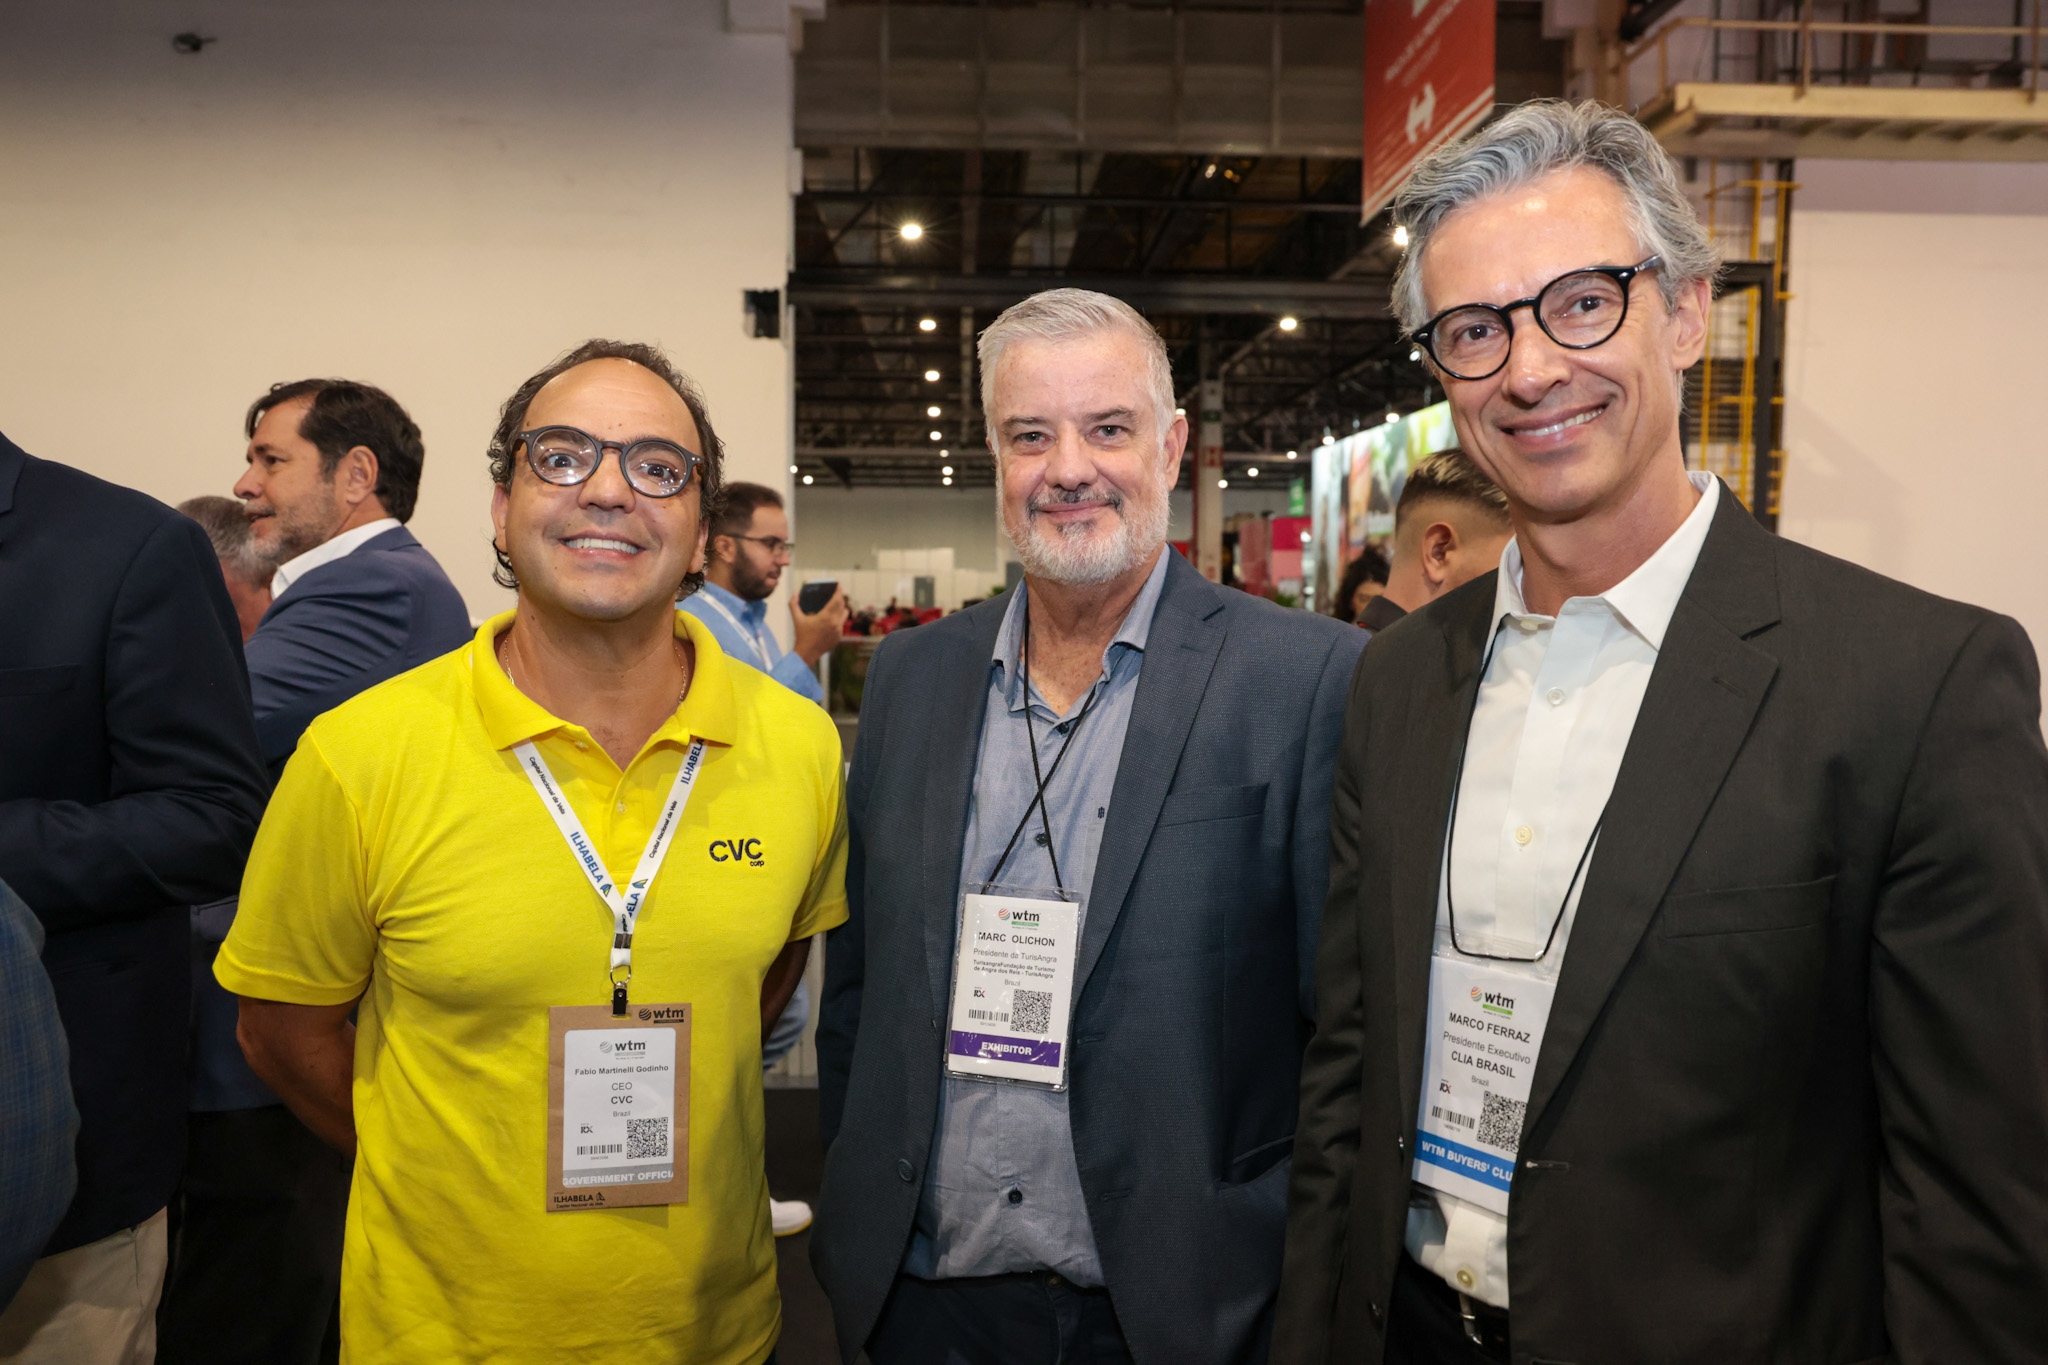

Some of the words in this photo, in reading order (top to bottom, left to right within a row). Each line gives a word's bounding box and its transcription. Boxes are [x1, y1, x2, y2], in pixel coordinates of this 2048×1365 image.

[681, 738, 704, 785] ILHABELA
[529, 756, 542, 775] Capital
[538, 771, 555, 796] Nacional
[649, 840, 661, 859] Capital
[658, 818, 670, 842] Nacional
[570, 831, 604, 883] ILHABELA
[709, 838, 763, 862] CVC
[1012, 910, 1040, 921] wtm
[978, 931, 1006, 942] MARC
[1011, 935, 1055, 947] OLICHON
[973, 948, 1008, 958] Presidente
[1020, 953, 1057, 963] TurisAngra
[1025, 971, 1053, 979] TurisAngra
[1034, 965, 1055, 973] Turismo
[1485, 992, 1514, 1009] wtm
[653, 1007, 684, 1019] wtm
[1449, 1012, 1484, 1031] MARCO
[1487, 1023, 1530, 1043] FERRAZ
[614, 1040, 646, 1051] wtm
[981, 1041, 1032, 1056] EXHIBITOR
[1443, 1031, 1485, 1052] Presidente
[1488, 1044, 1531, 1064] Executivo
[574, 1068, 597, 1076] Fabio
[599, 1066, 634, 1075] Martinelli
[636, 1065, 669, 1073] Godinho
[1451, 1050, 1473, 1066] CLIA
[1476, 1058, 1516, 1078] BRASIL
[611, 1082, 633, 1091] CEO
[1471, 1075, 1489, 1087] Brazil
[610, 1096, 633, 1105] CVC
[613, 1110, 631, 1118] Brazil
[1422, 1140, 1446, 1158] WTM
[1447, 1150, 1490, 1173] BUYERS'
[562, 1173, 635, 1186] GOVERNMENT
[553, 1194, 593, 1203] ILHABELA
